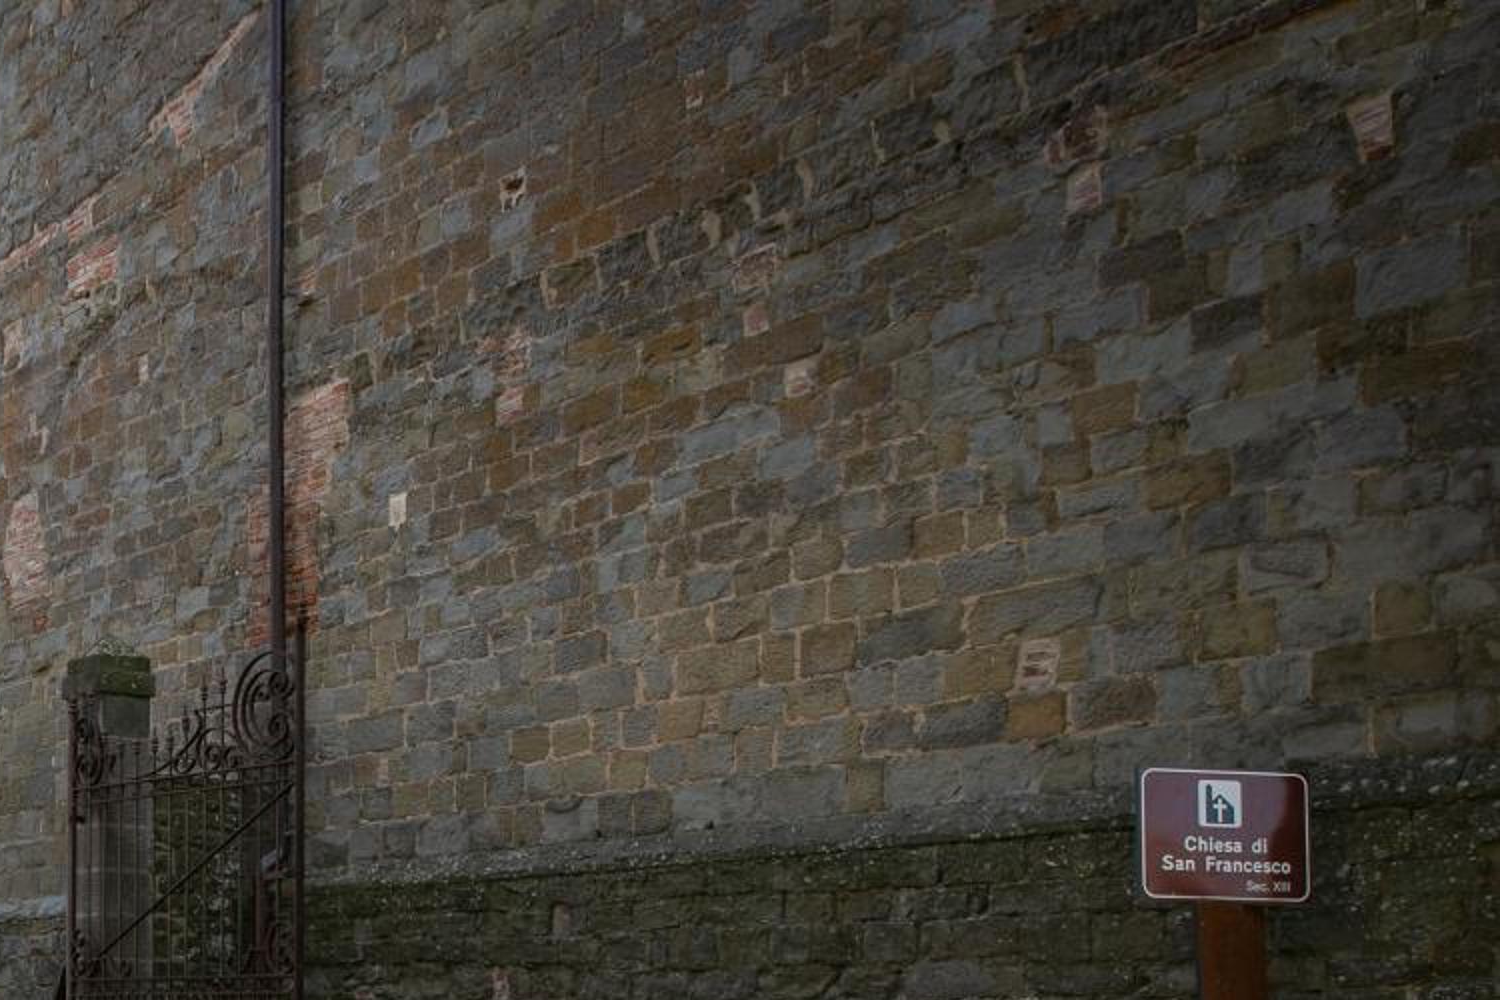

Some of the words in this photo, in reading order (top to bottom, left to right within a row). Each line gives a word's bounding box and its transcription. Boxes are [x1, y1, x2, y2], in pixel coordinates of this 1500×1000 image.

[1184, 835, 1243, 854] Chiesa
[1251, 837, 1268, 854] di
[1161, 854, 1196, 872] San
[1205, 855, 1291, 874] Francesco
